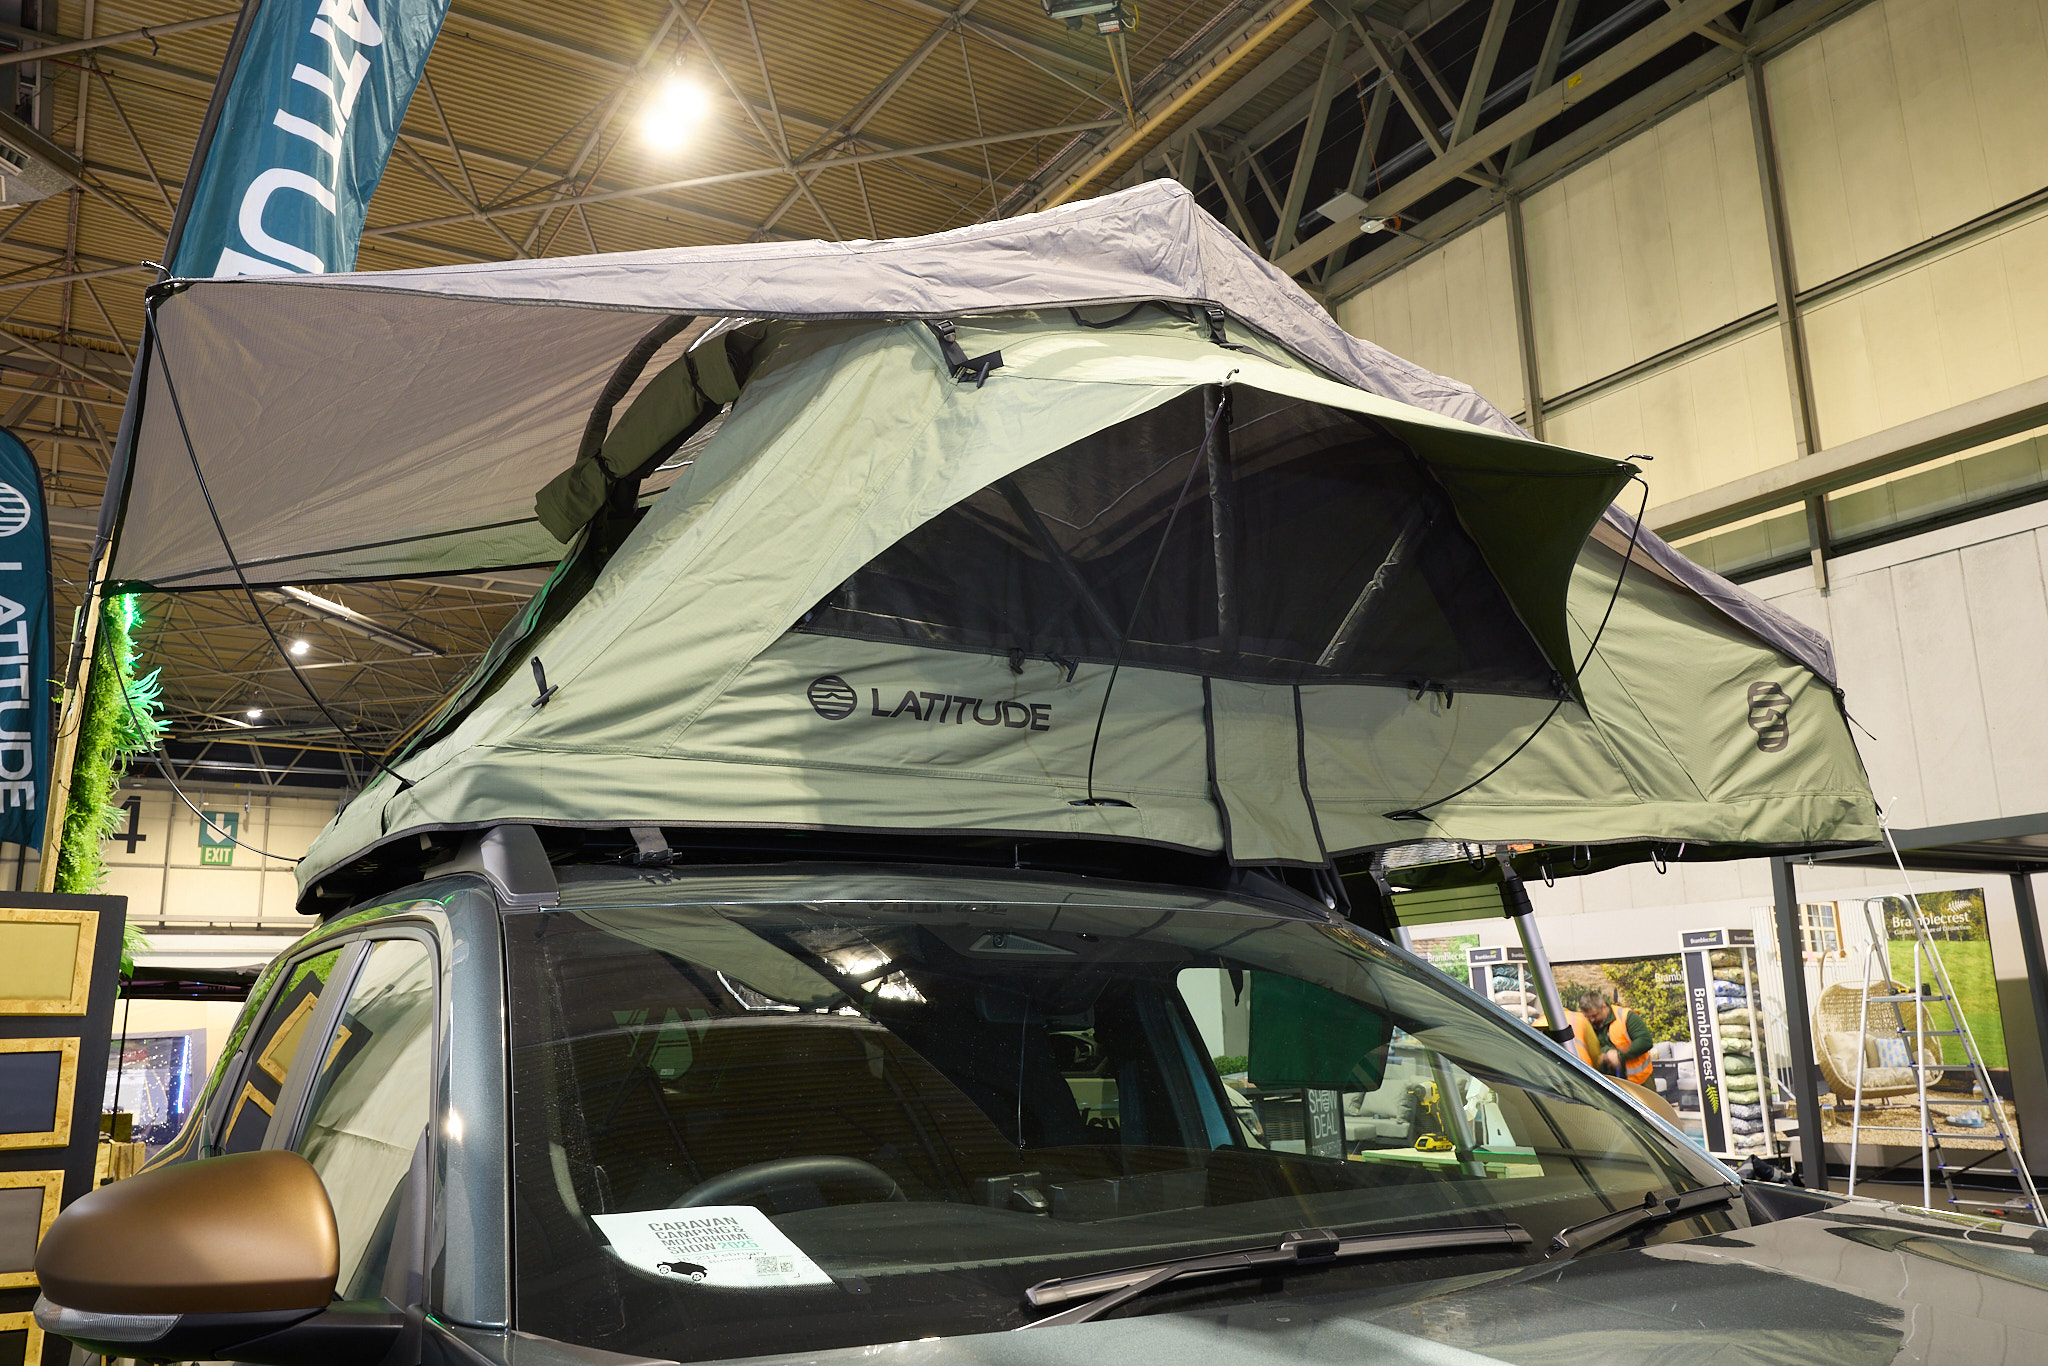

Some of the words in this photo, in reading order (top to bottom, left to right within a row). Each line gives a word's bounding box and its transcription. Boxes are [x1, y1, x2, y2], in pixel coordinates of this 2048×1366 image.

[871, 688, 1052, 731] LATITUDE
[204, 847, 231, 863] EXIT
[1693, 988, 1716, 1081] Bramblecrest
[1314, 1112, 1338, 1139] DEAL
[648, 1217, 739, 1232] CARAVAN
[655, 1225, 731, 1240] CAMPING
[732, 1224, 746, 1233] &
[661, 1233, 753, 1247] MOTORHOME
[667, 1242, 717, 1255] SHOW
[717, 1240, 760, 1250] 2025
